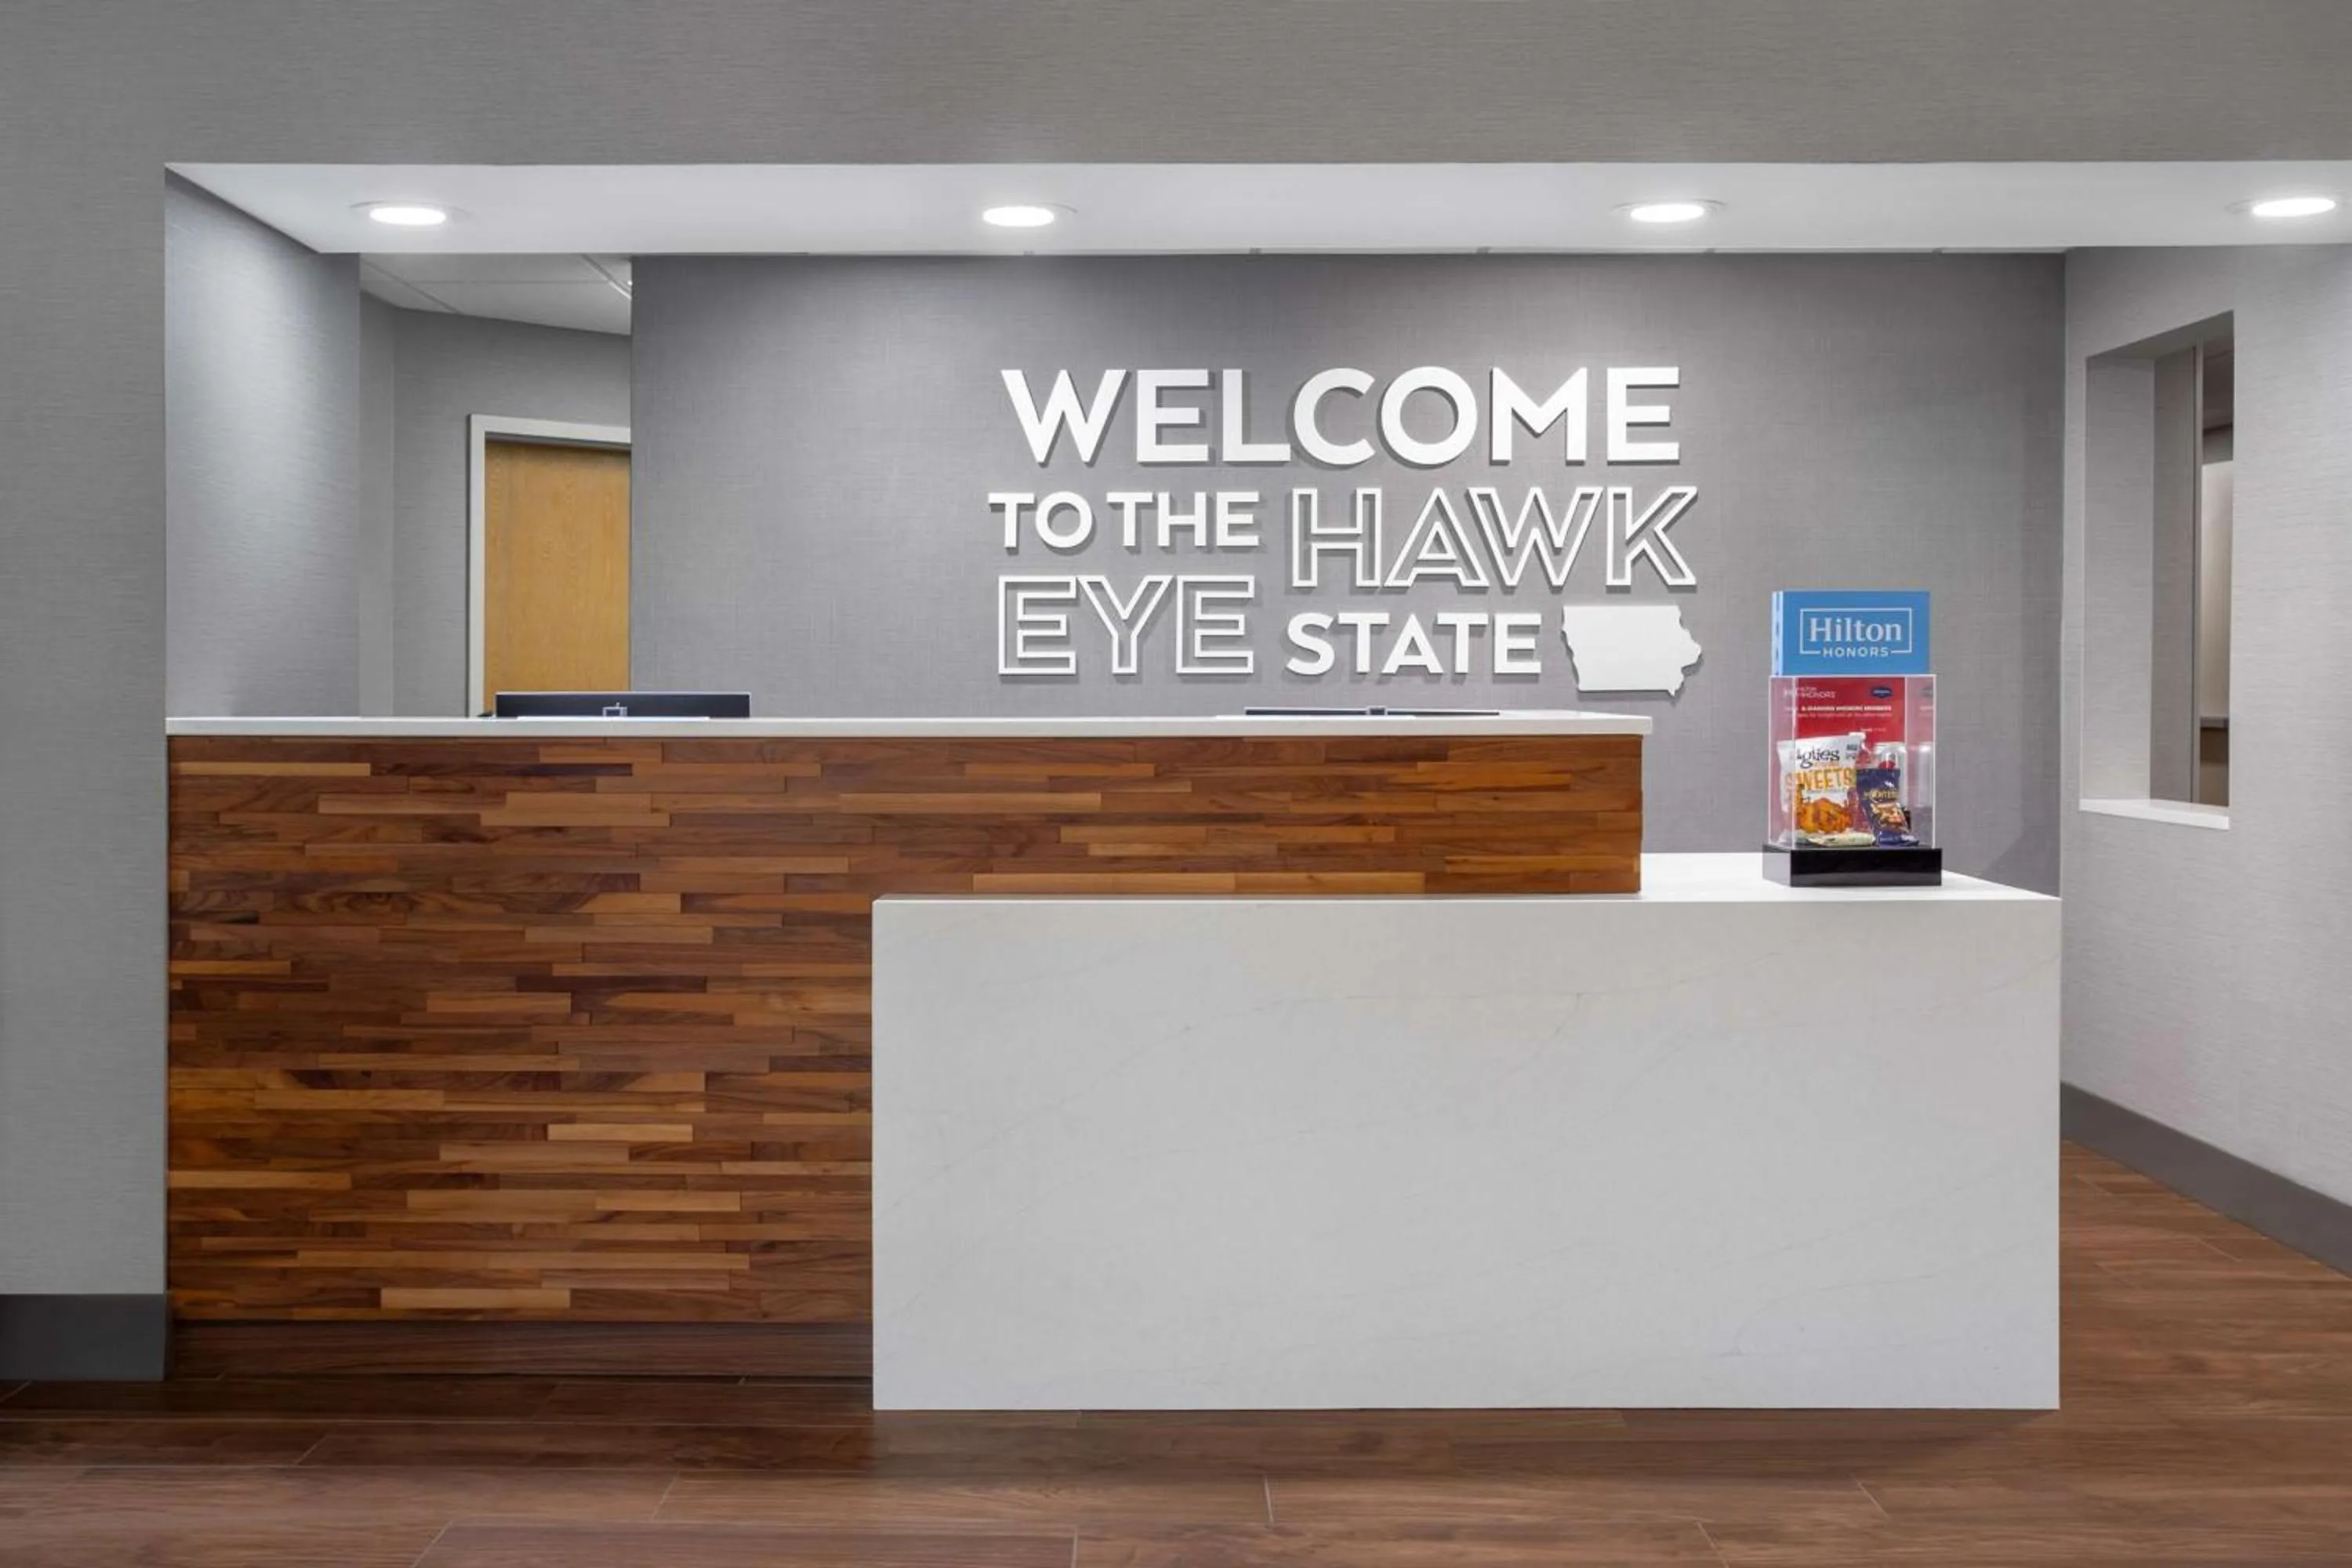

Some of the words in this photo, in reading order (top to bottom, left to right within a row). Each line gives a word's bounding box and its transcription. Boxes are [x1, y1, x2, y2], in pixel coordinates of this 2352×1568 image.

[1001, 367, 1680, 465] WELCOME
[989, 492, 1092, 548] TO
[1107, 492, 1260, 546] THE
[1292, 487, 1698, 588] HAWK
[998, 575, 1254, 675] EYE
[1286, 612, 1542, 675] STATE
[1809, 617, 1902, 642] Hilton
[1823, 647, 1889, 657] HONORS
